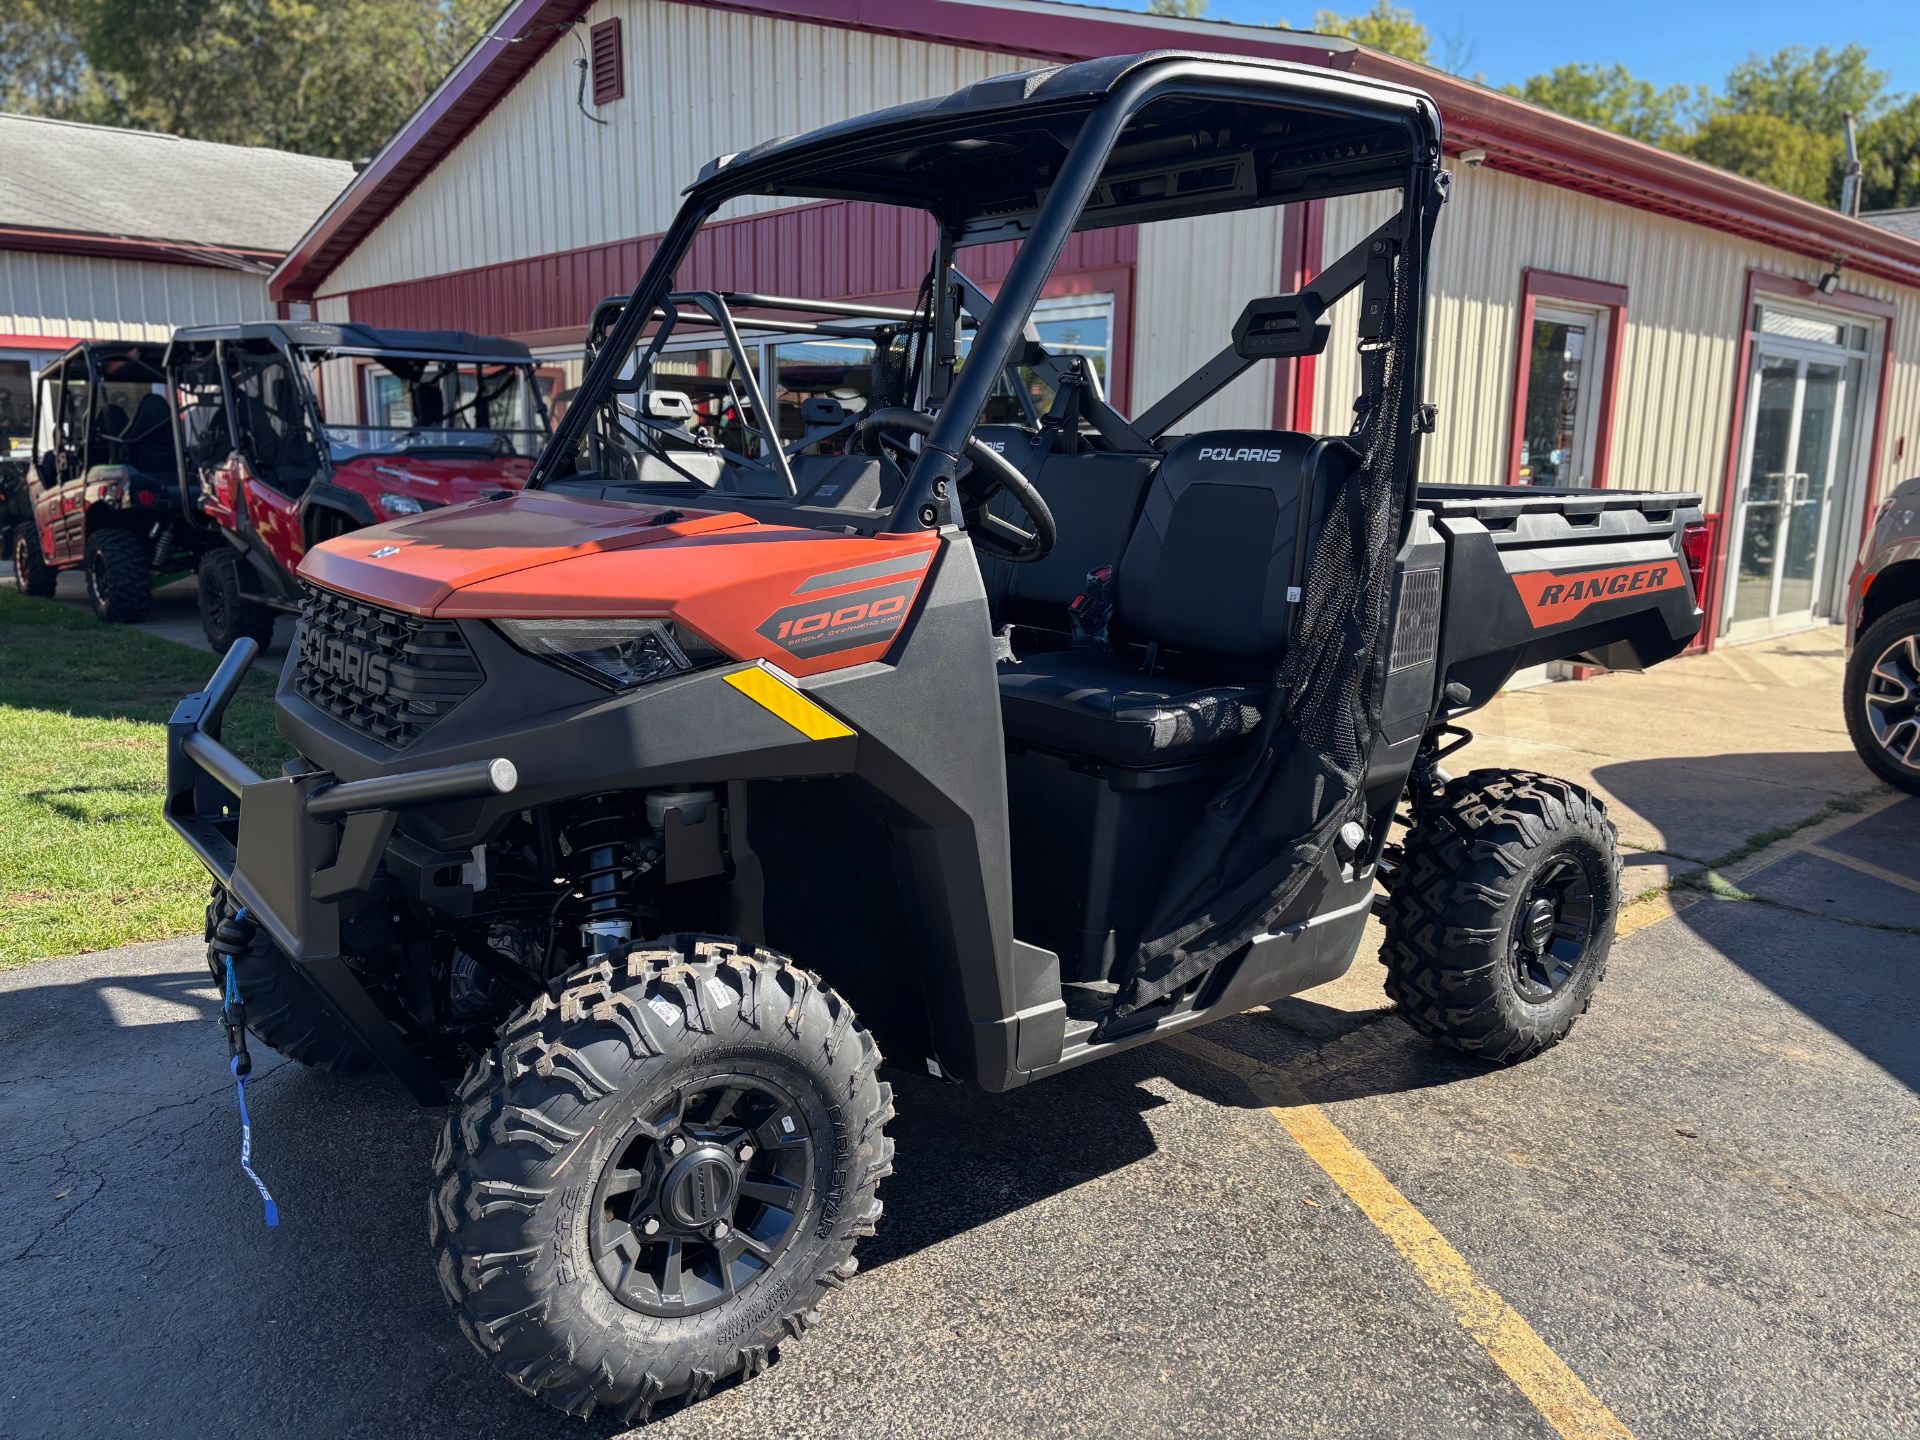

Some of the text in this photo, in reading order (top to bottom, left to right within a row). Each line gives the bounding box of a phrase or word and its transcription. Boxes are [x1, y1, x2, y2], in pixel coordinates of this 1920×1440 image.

[1198, 448, 1282, 462] POLARIS
[1537, 567, 1668, 607] RANGER
[777, 595, 906, 640] 1000
[787, 615, 901, 646] SINGLE OVERHEAD CAM
[295, 619, 389, 696] POLARIS
[241, 1124, 273, 1201] POLARIS
